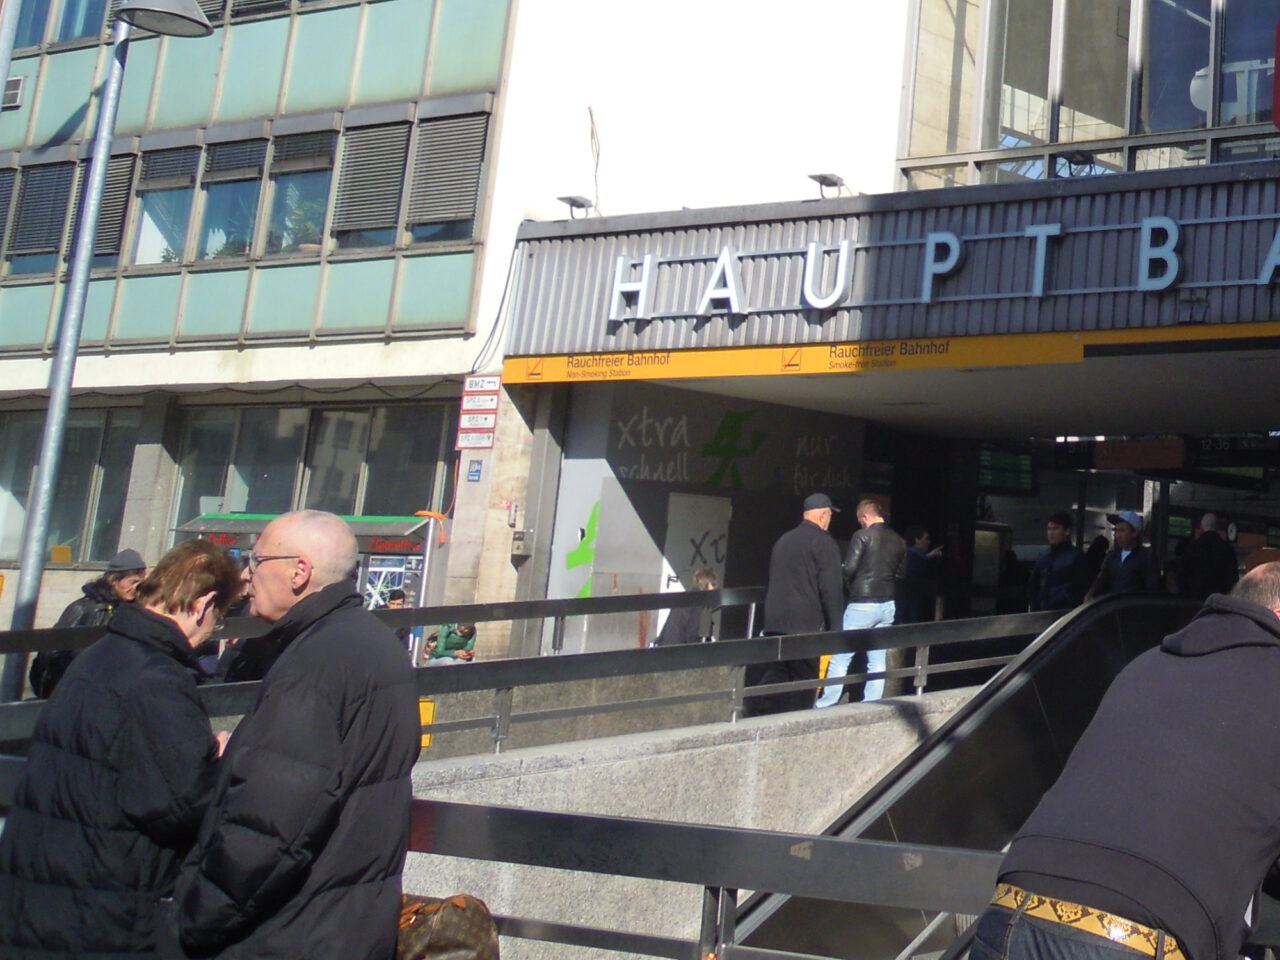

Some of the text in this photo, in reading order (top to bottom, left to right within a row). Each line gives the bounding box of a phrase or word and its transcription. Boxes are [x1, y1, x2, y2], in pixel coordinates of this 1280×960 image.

[829, 340, 951, 359] Rauchfreier Bahnhof
[567, 351, 671, 369] Rauchfreier Bahnhof
[869, 358, 896, 369] Station
[609, 368, 632, 378] Station
[617, 406, 691, 450] xtra
